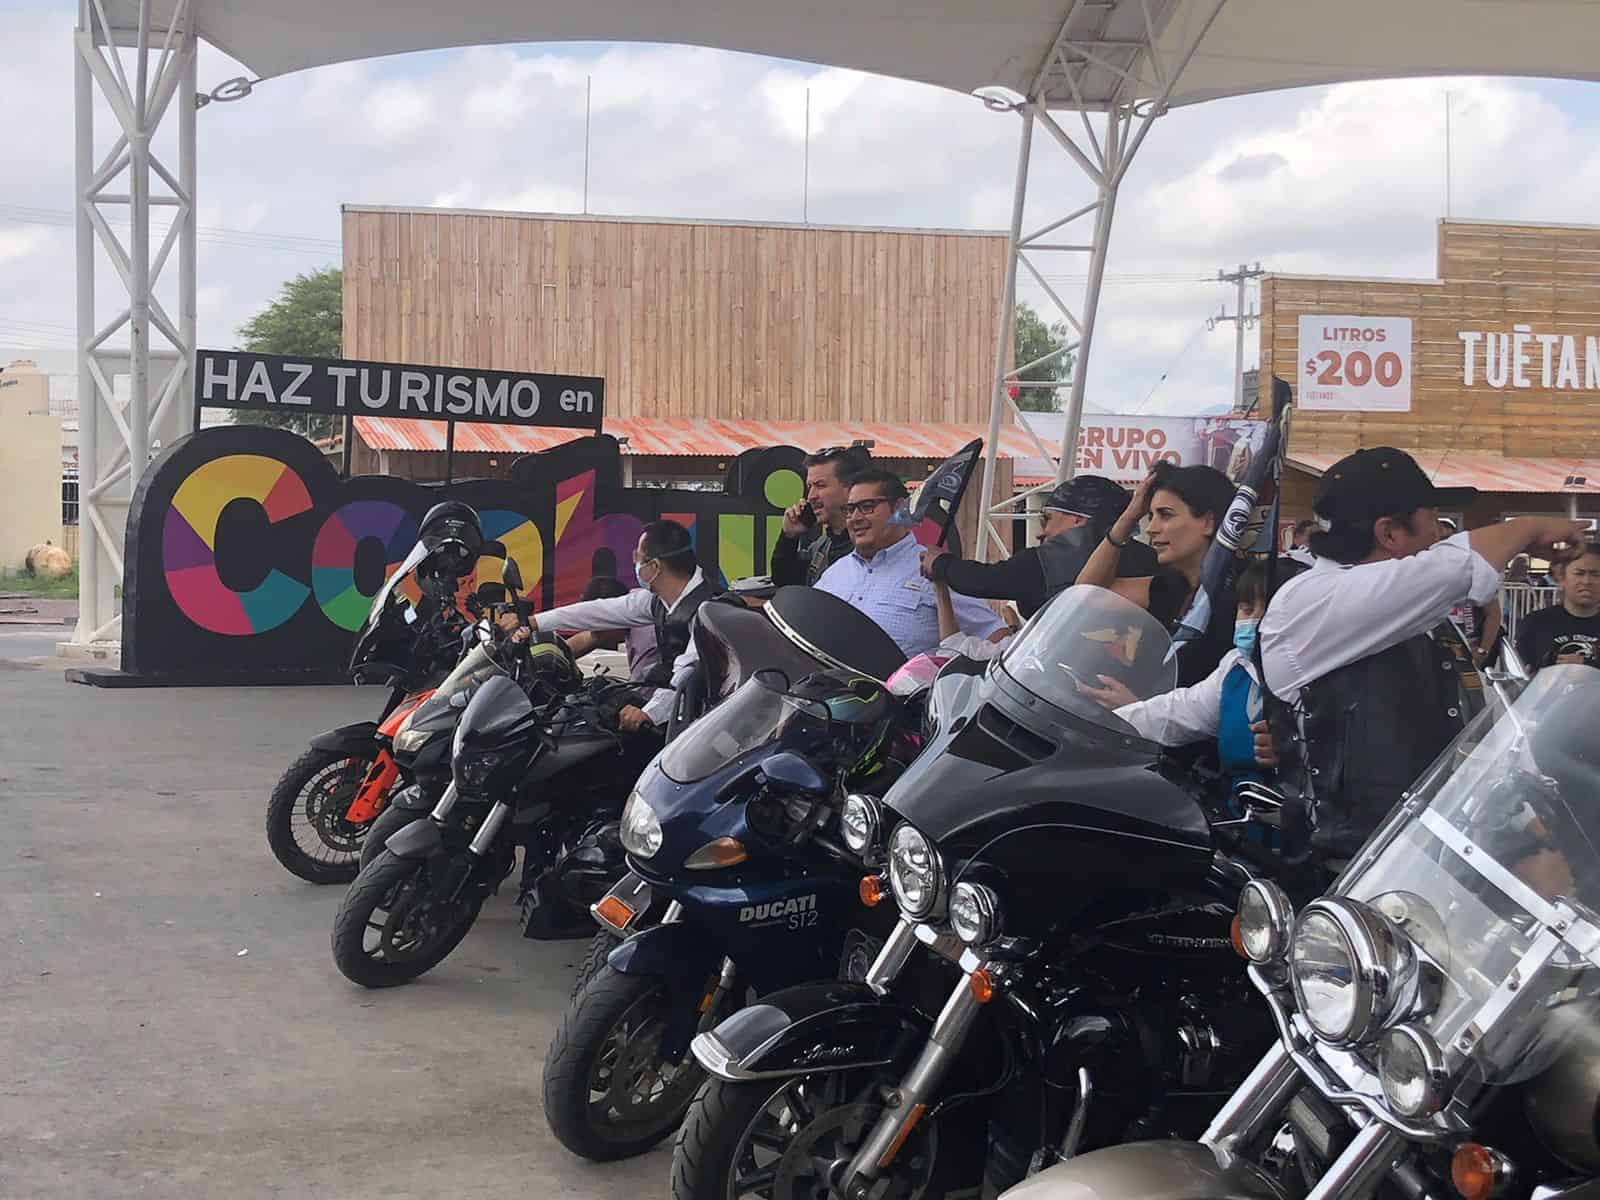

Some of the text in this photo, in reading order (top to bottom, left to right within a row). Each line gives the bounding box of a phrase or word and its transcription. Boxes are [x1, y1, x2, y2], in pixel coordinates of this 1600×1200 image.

[1323, 327, 1386, 342] LITROS
[1305, 350, 1402, 387] $200
[202, 357, 593, 418] HAZ TURISMO en
[739, 894, 816, 922] DUCATI
[788, 910, 819, 930] ST2
